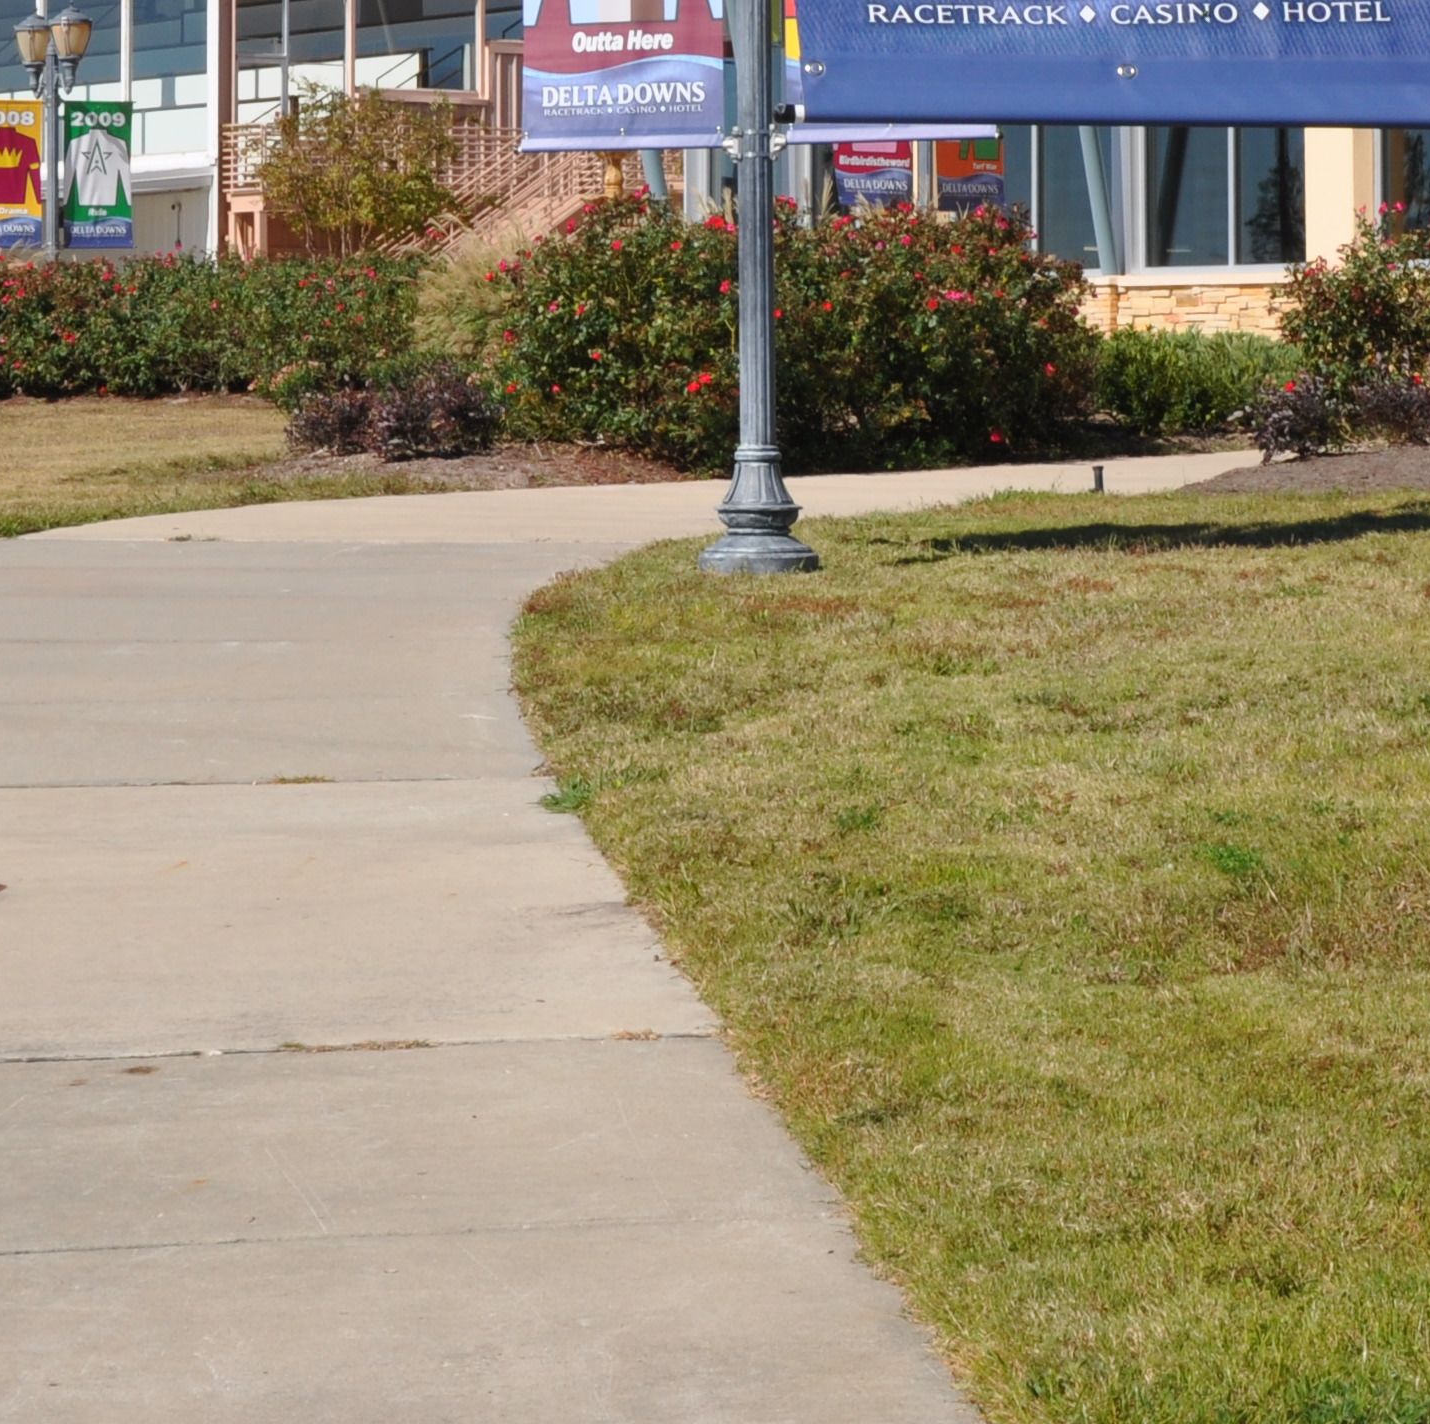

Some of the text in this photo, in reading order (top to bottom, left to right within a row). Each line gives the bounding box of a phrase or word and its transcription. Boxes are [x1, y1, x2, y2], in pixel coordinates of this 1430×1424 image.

[868, 0, 1391, 26] RACETRACK CASINO HOTEL
[572, 29, 674, 53] Outta Here
[541, 81, 706, 108] DELTA DOWNS
[543, 103, 703, 117] RACETRACK CASINO HOTEL
[71, 111, 126, 126] 2009
[843, 178, 909, 191] DELTA DOWNS
[942, 182, 999, 194] DELTA DOWNS
[3, 224, 36, 234] DOWNS
